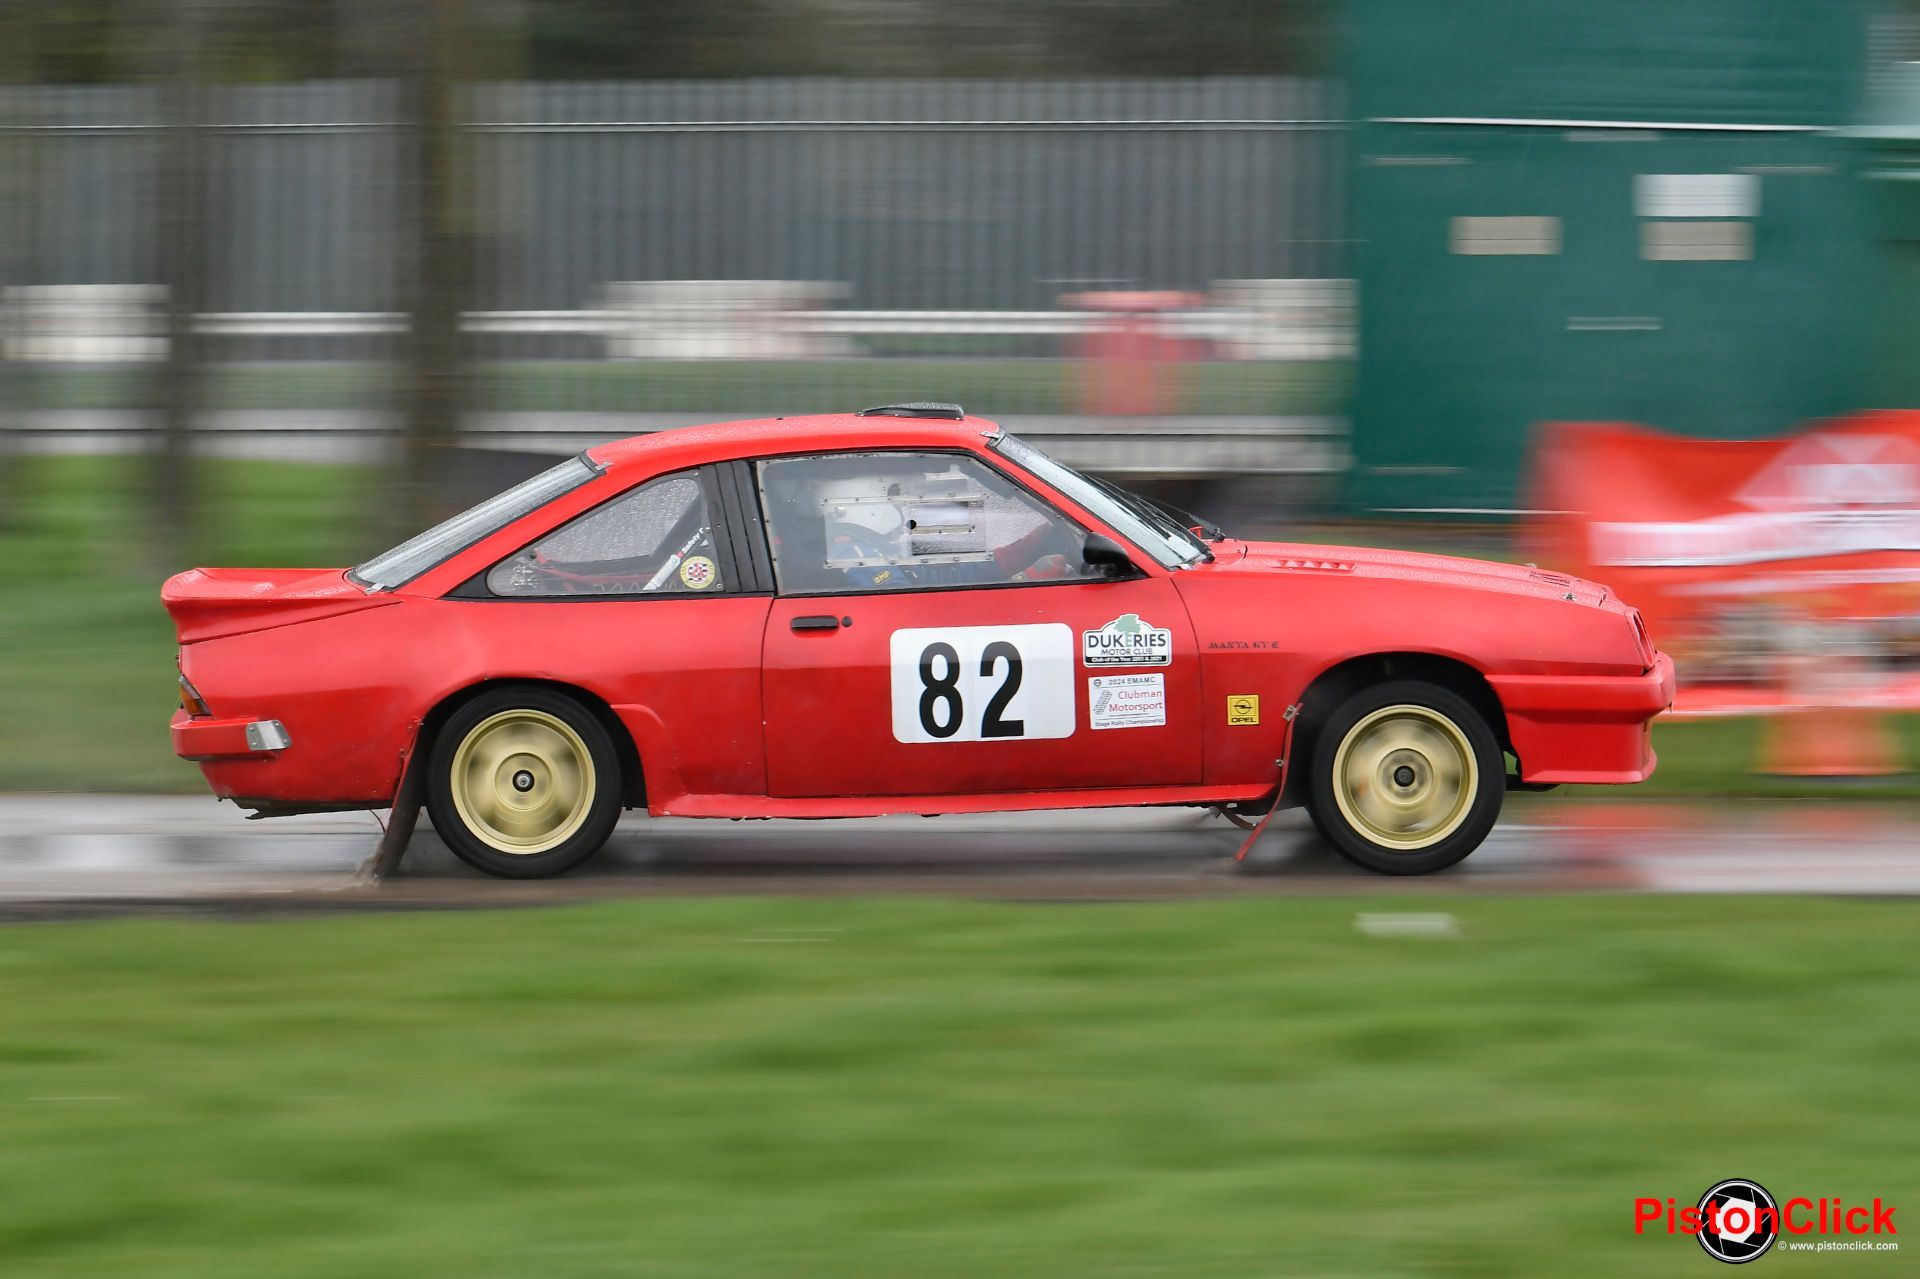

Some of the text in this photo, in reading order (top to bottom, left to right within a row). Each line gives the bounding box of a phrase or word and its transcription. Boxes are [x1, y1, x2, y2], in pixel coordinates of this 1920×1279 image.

[1087, 633, 1167, 648] DUKERIES
[919, 641, 1024, 738] 82
[1118, 690, 1163, 700] Clubman
[1109, 702, 1163, 712] Motorsport
